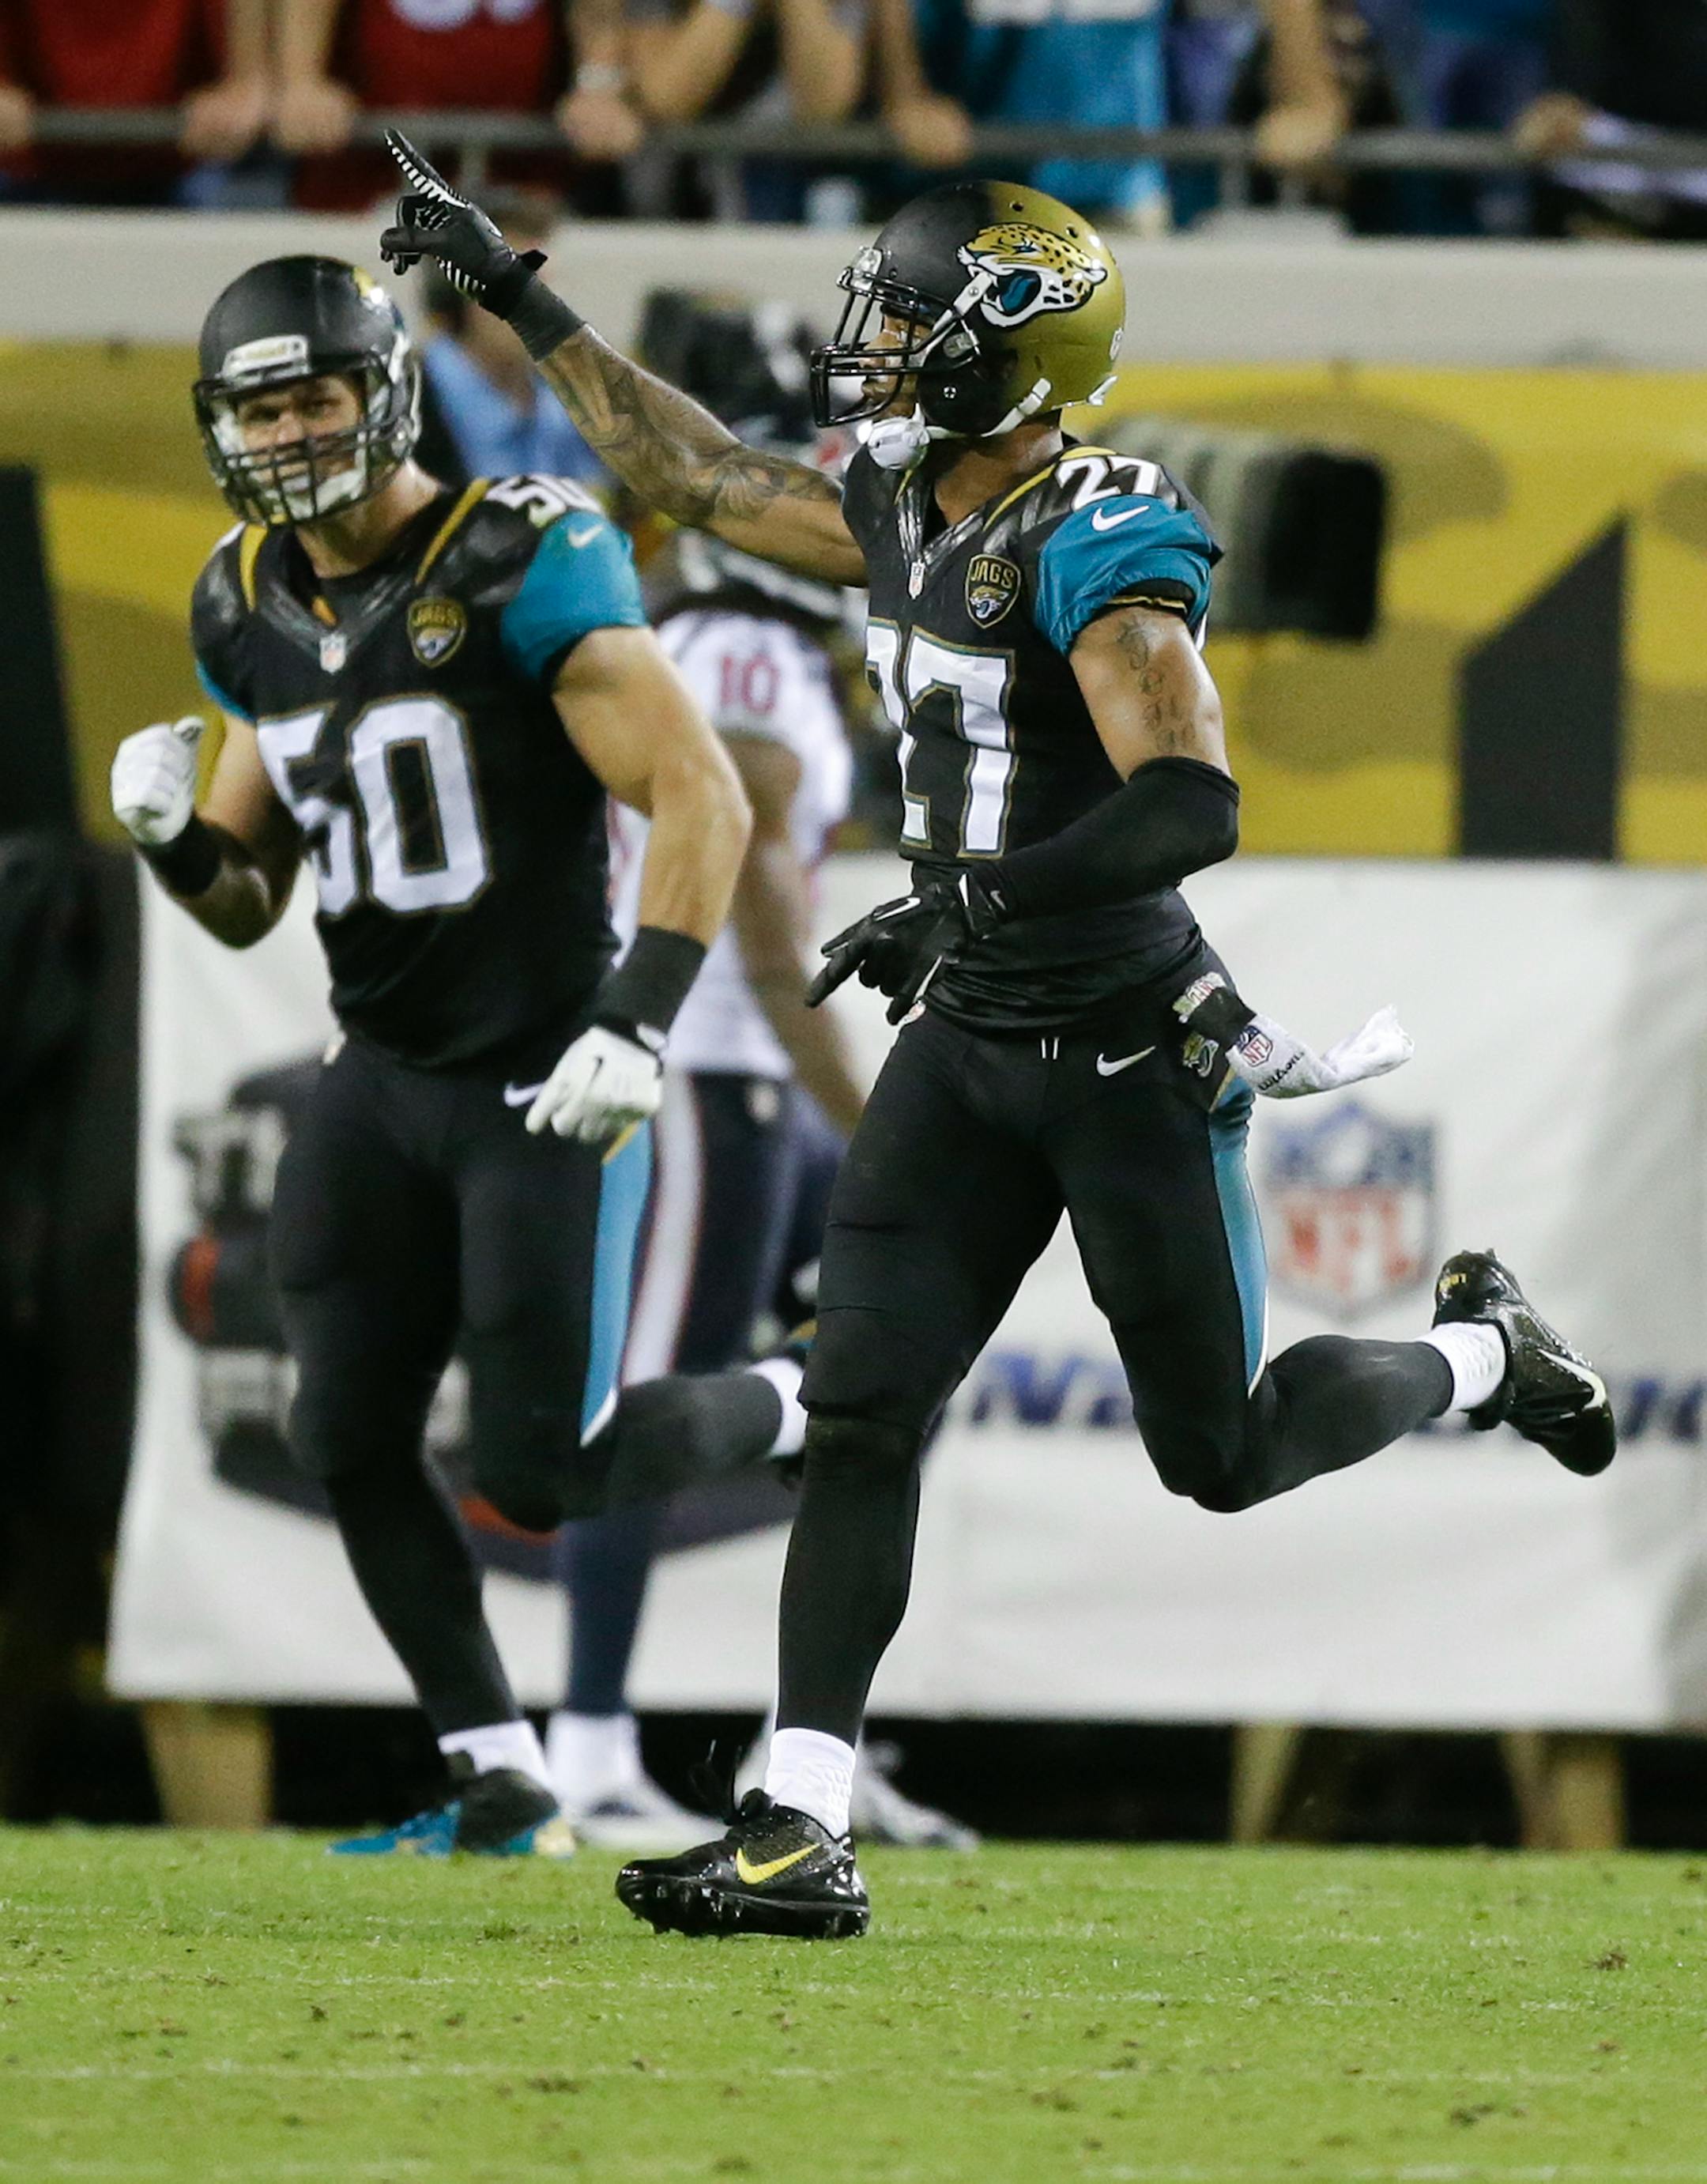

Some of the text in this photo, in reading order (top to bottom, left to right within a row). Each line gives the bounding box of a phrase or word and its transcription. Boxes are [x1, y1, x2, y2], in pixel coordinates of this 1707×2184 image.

[485, 474, 603, 528] 50
[1054, 456, 1159, 511] 27
[970, 560, 1014, 589] JAGS
[720, 653, 780, 715] 10
[256, 694, 491, 920] 50
[1243, 1035, 1269, 1066] NFL
